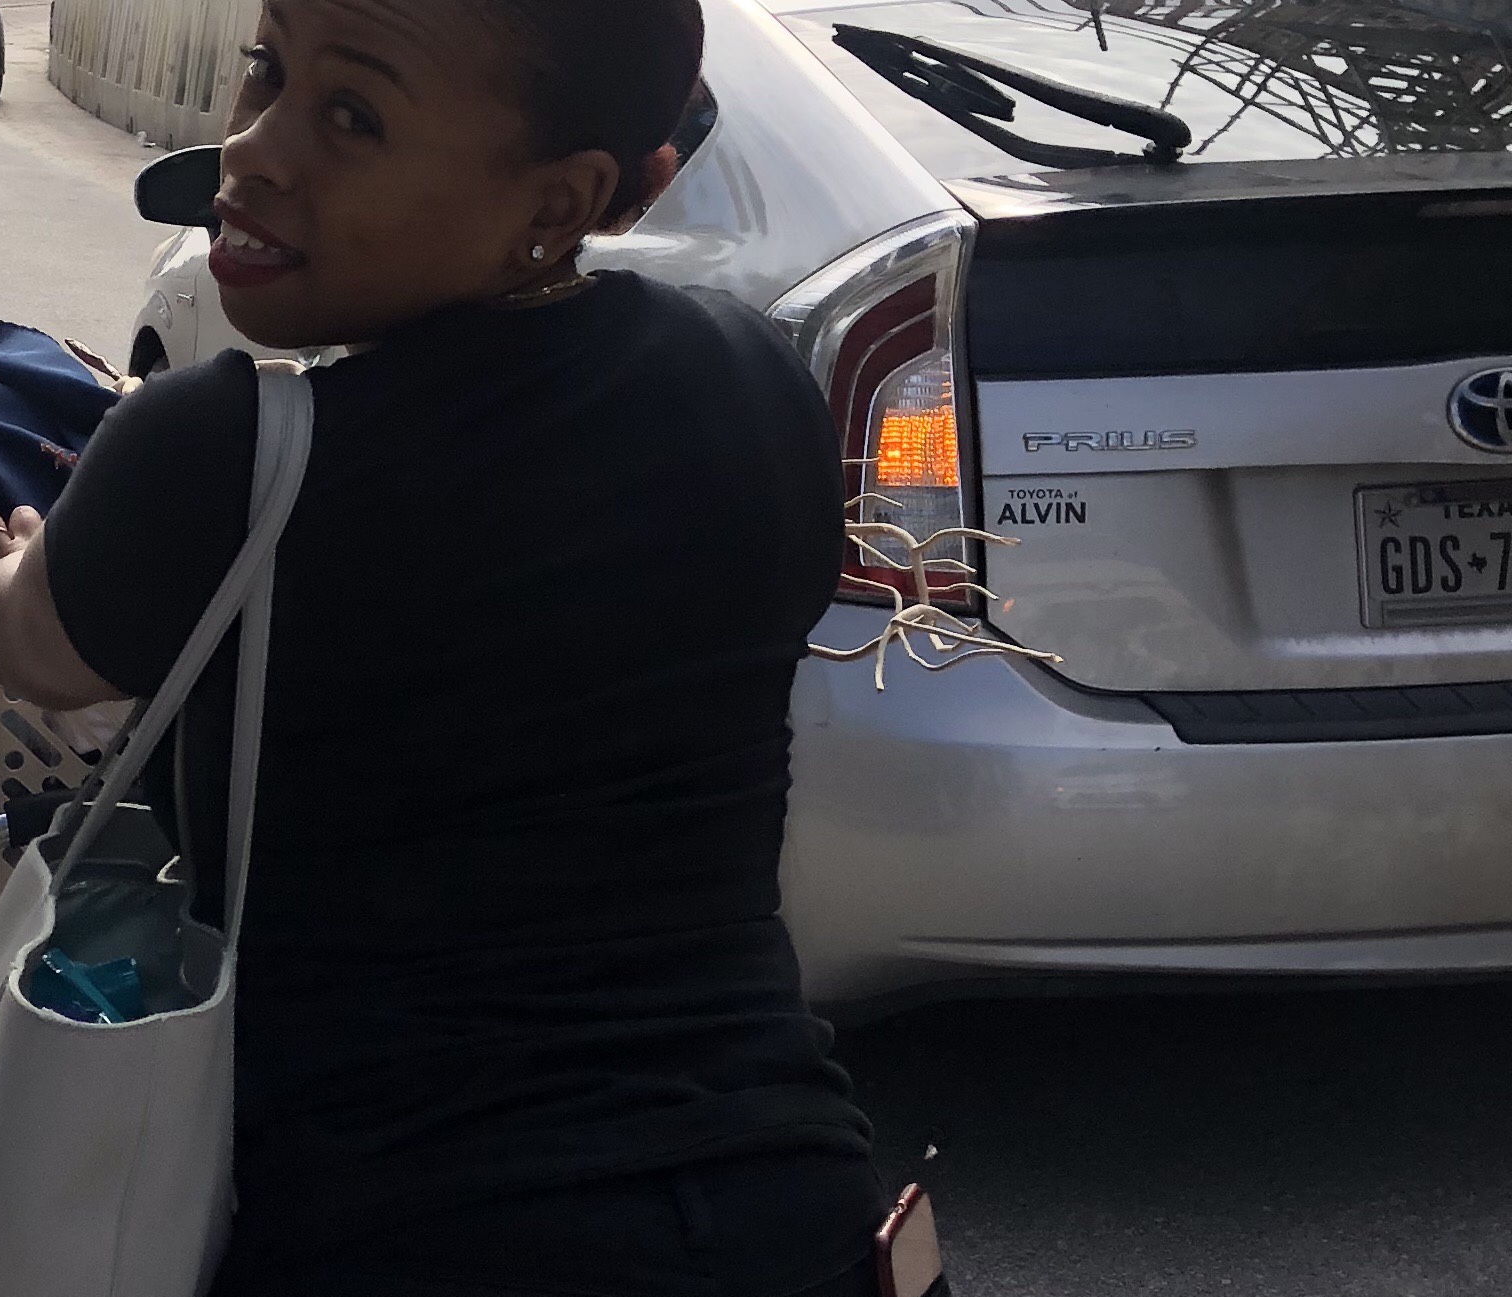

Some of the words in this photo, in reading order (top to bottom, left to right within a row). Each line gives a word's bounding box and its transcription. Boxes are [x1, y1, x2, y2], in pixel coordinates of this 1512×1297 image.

[1023, 429, 1198, 452] PRIUS
[1008, 489, 1064, 500] TOYOTA
[1067, 490, 1078, 499] of
[997, 501, 1087, 525] ALVIN
